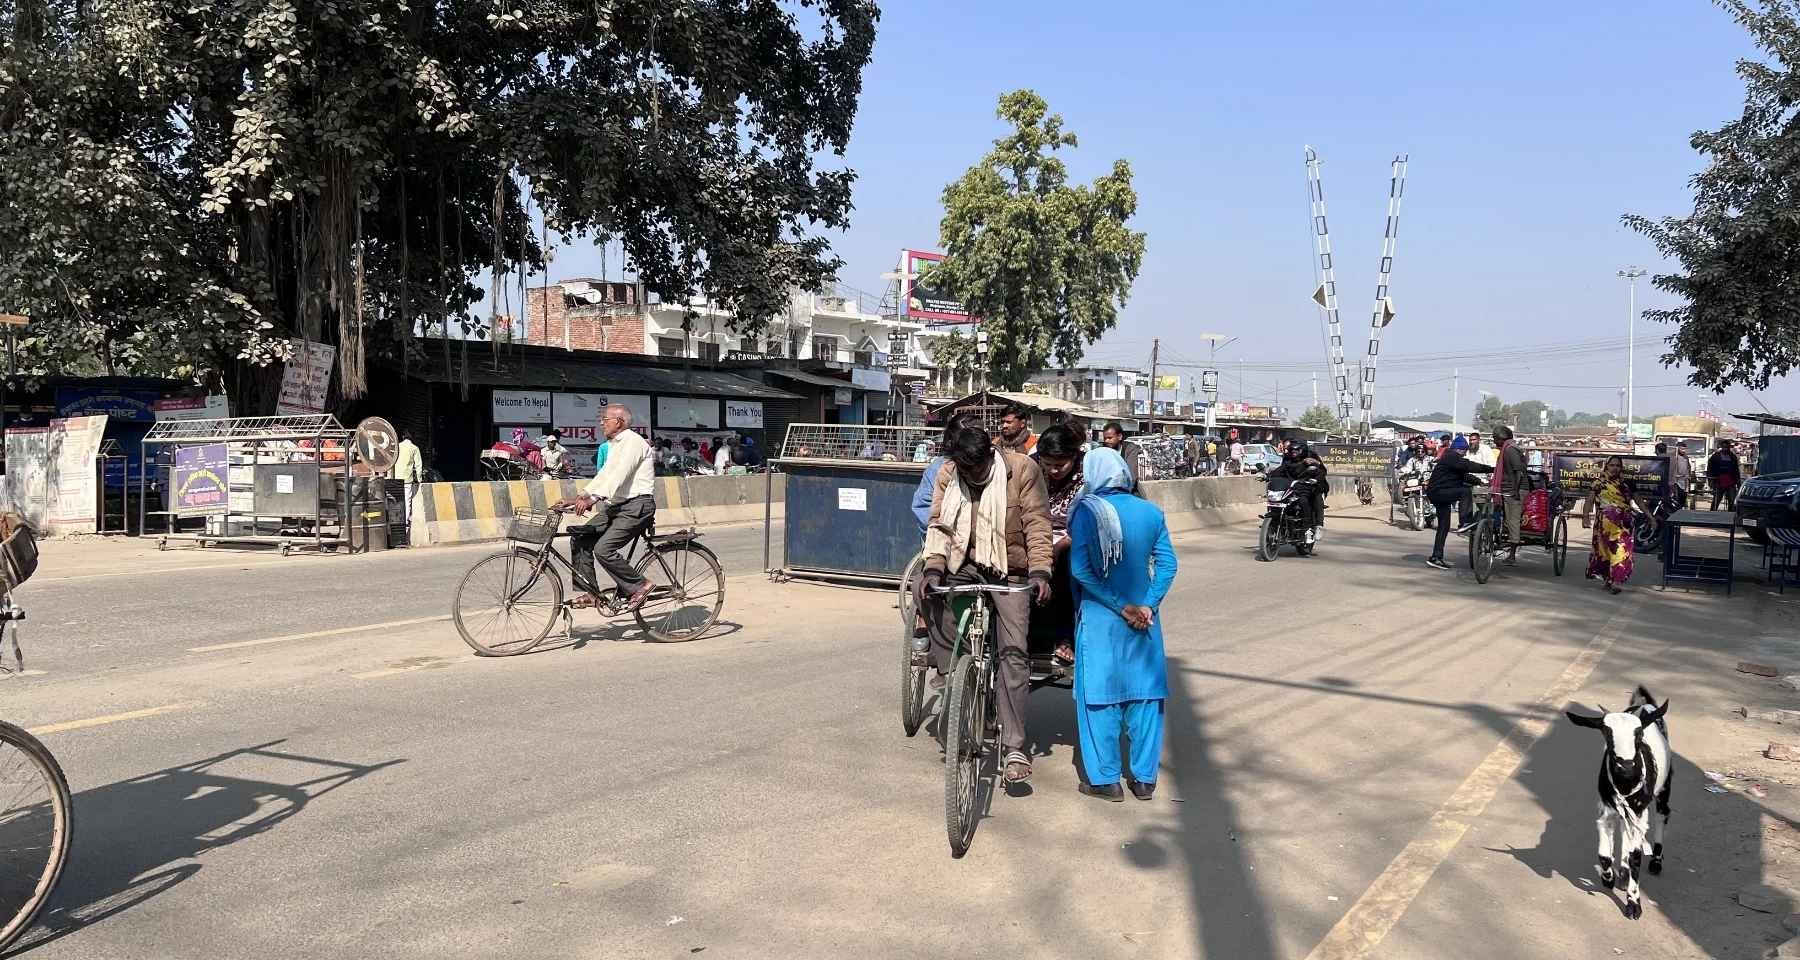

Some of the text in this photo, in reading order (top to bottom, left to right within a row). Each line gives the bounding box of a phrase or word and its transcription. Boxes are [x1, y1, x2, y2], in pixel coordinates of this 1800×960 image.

[494, 396, 548, 410] Welcome To Nepal
[728, 406, 762, 418] Thank You
[558, 426, 598, 442] यात्रु
[1576, 460, 1599, 470] Safe
[1560, 468, 1584, 478] Thank
[1586, 470, 1600, 478] You
